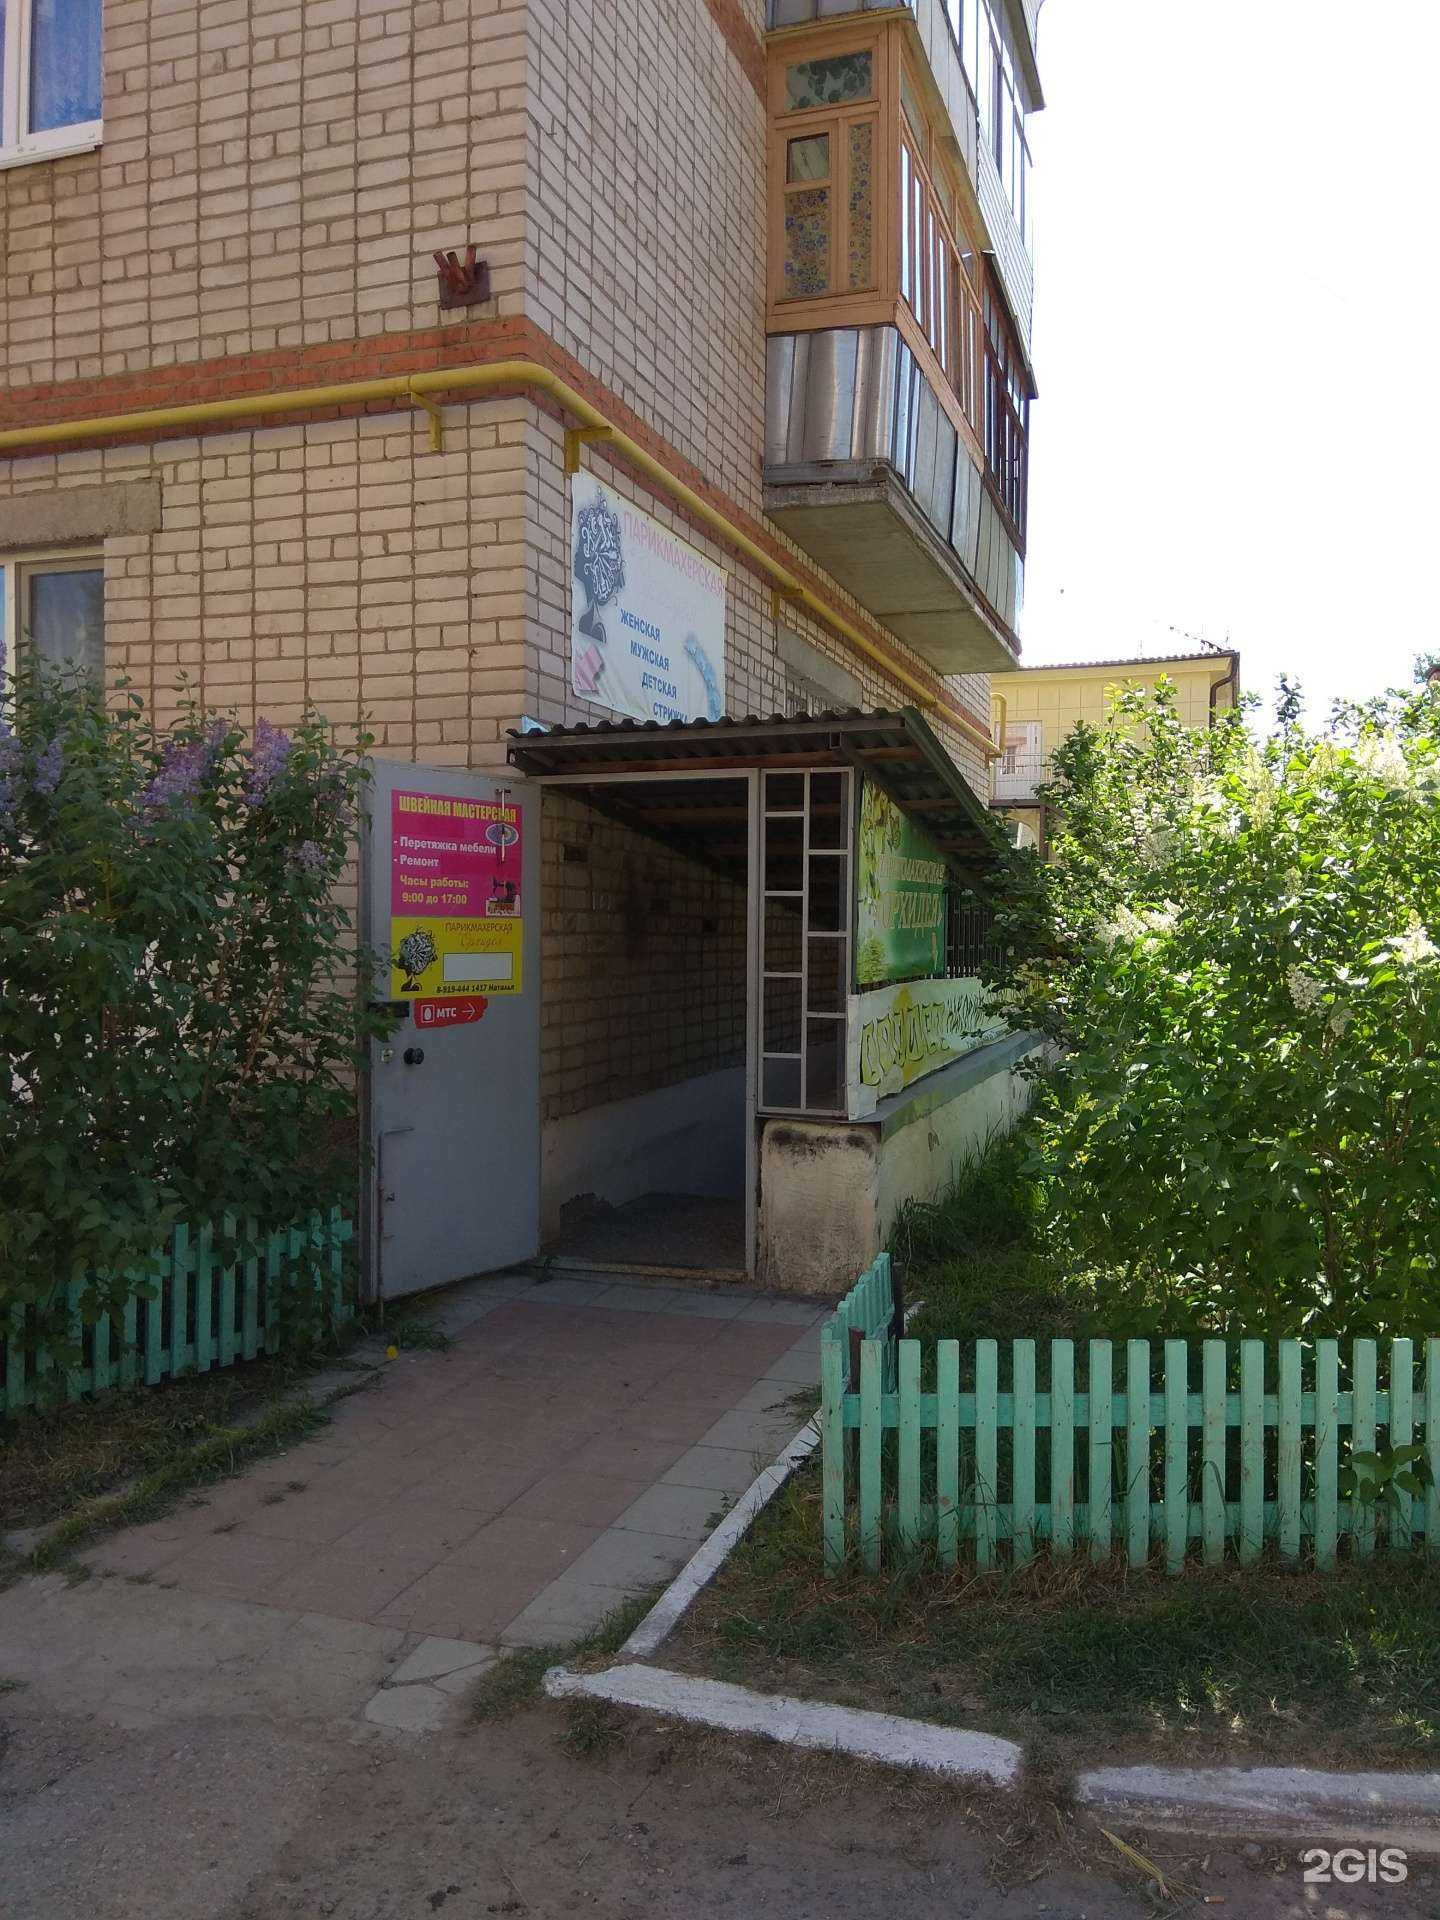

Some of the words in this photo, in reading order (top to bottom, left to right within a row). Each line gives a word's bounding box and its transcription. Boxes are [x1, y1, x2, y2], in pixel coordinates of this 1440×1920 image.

[622, 511, 724, 596] ПАРИКМАХЕРСКАЯ
[620, 608, 661, 643] ЖЕНСКАЯ
[630, 640, 670, 671] МУЖСКАЯ
[641, 672, 677, 699] ДЕТСКАЯ
[399, 795, 451, 817] ШВЕЙНАЯ
[453, 802, 517, 823] МАСТЕРСКАЯ
[400, 836, 457, 852] Перетяжка
[459, 844, 497, 855] мебели
[400, 855, 439, 867] Ремонт
[400, 875, 428, 887] Часы
[431, 876, 469, 889] работы:
[402, 892, 424, 903] 9:00
[426, 895, 438, 905] до
[442, 893, 467, 905] 17:00
[445, 922, 513, 934] ПАРИКМАХЕРСКАЯ
[436, 1005, 457, 1018] МТС
